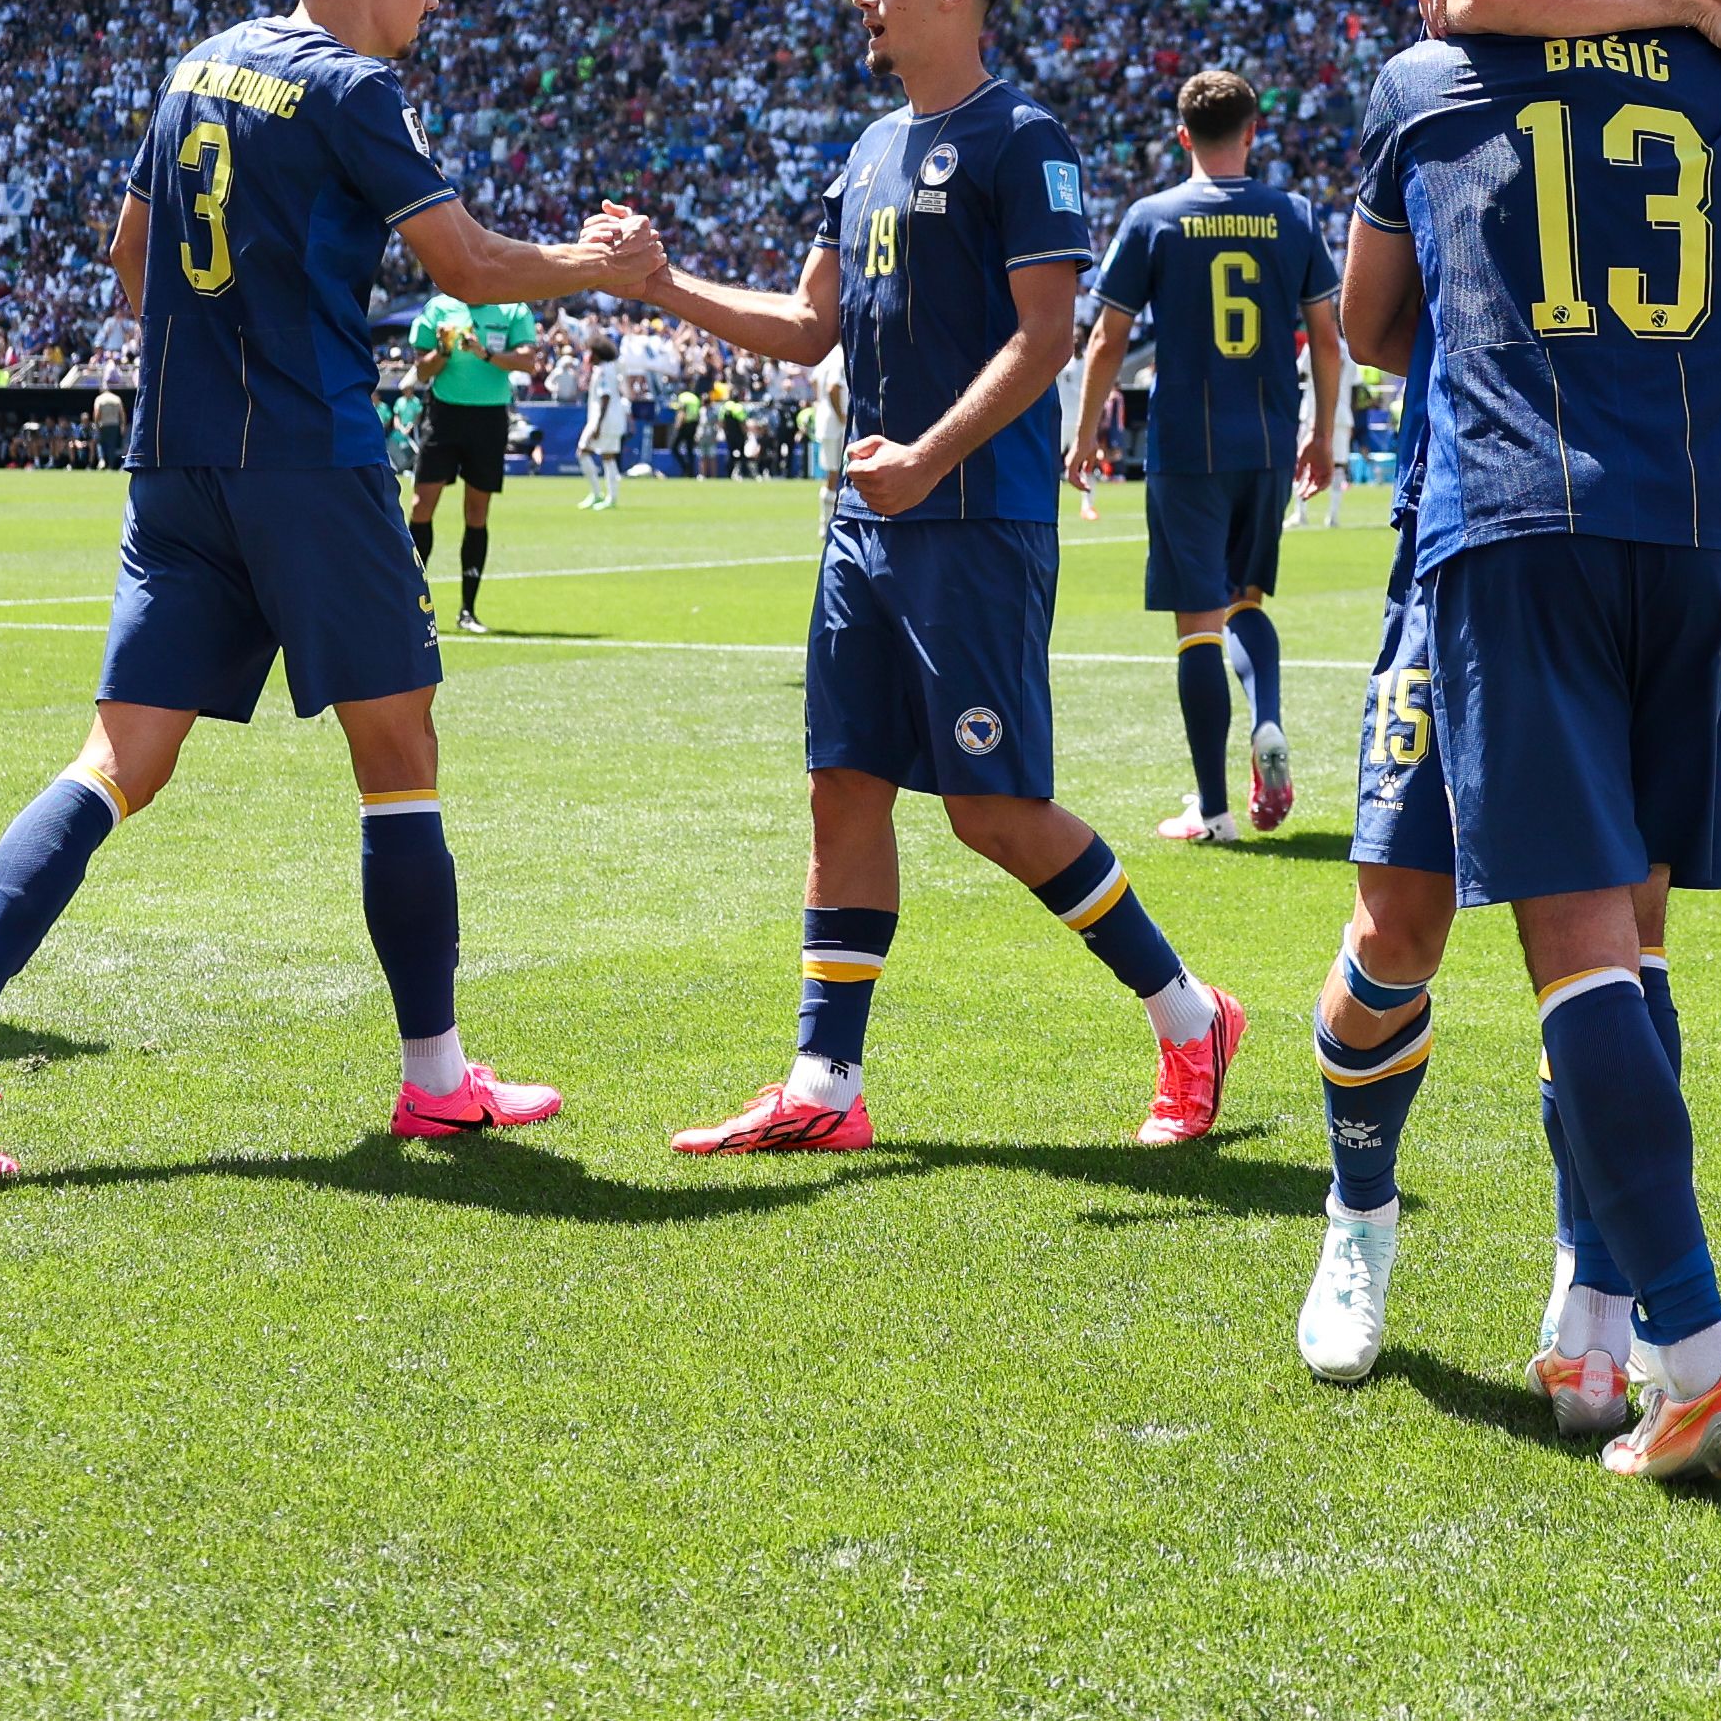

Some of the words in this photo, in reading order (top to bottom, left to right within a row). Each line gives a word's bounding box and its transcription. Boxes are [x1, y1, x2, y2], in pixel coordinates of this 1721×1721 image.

[1544, 35, 1670, 82] BAŠIĆ
[178, 121, 235, 298] 3
[865, 205, 897, 279] 19
[1180, 213, 1278, 239] TAHIROVIĆ
[1515, 99, 1713, 341] 13
[1210, 251, 1261, 359] 6
[1369, 668, 1432, 765] 15
[1372, 799, 1404, 811] KELME
